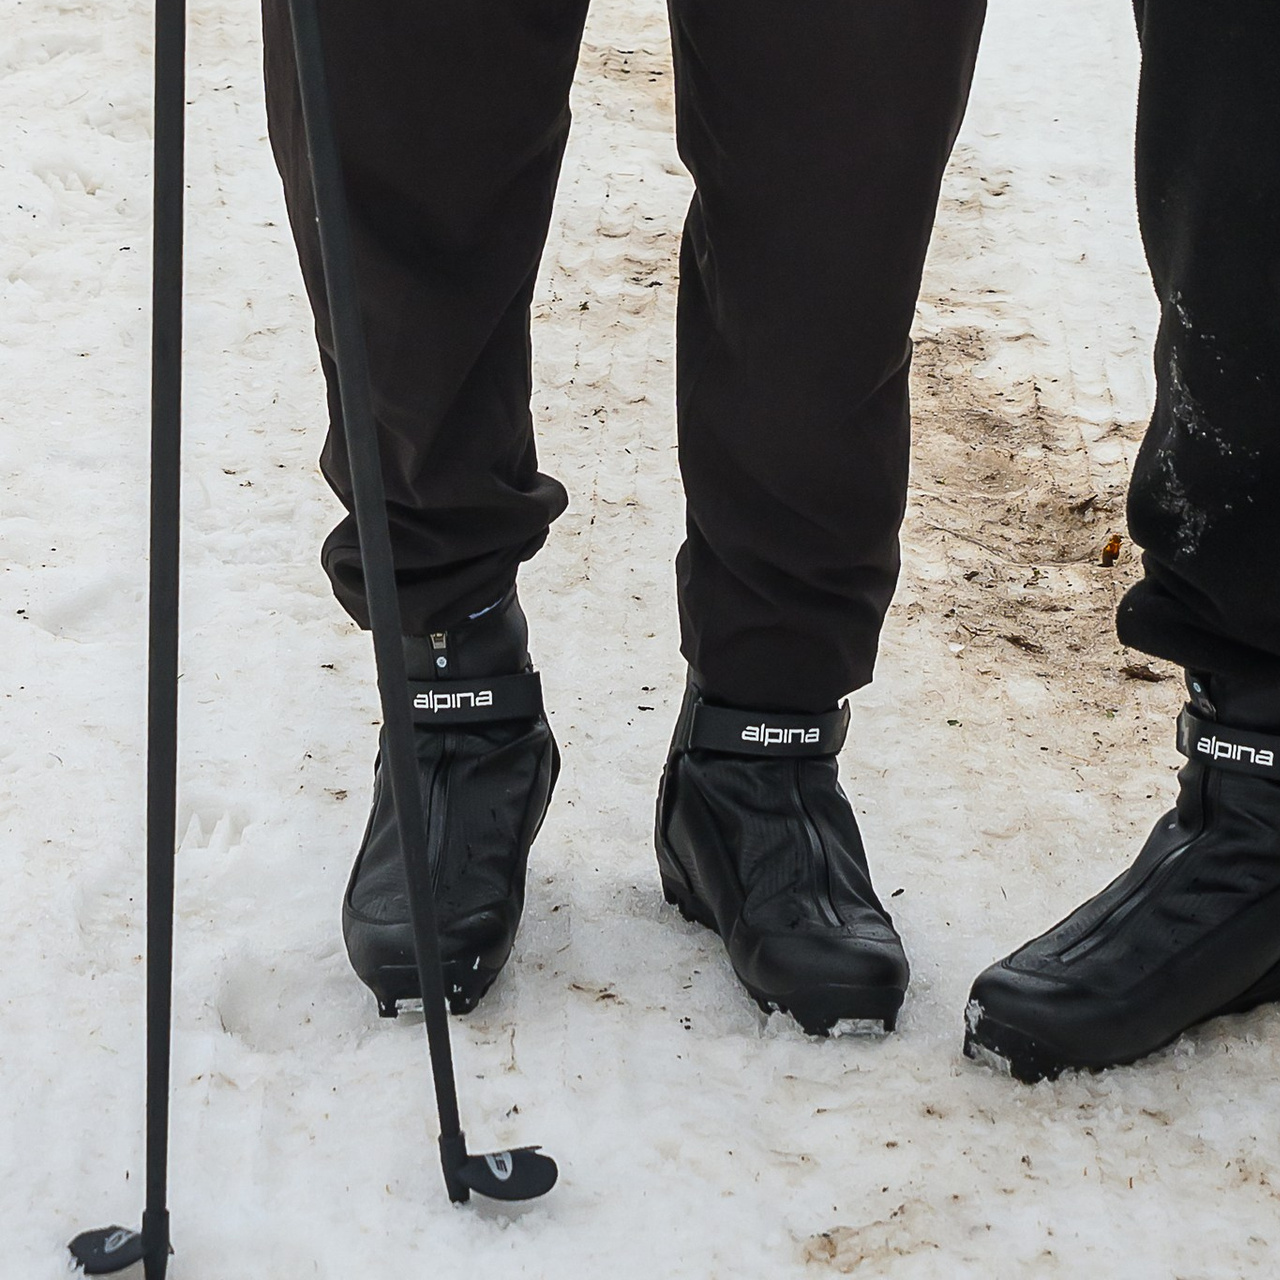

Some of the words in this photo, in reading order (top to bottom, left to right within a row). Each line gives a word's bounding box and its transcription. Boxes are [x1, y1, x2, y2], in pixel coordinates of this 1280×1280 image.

[413, 689, 494, 714] alpina
[741, 723, 821, 748] alpina
[1196, 735, 1275, 767] alpina
